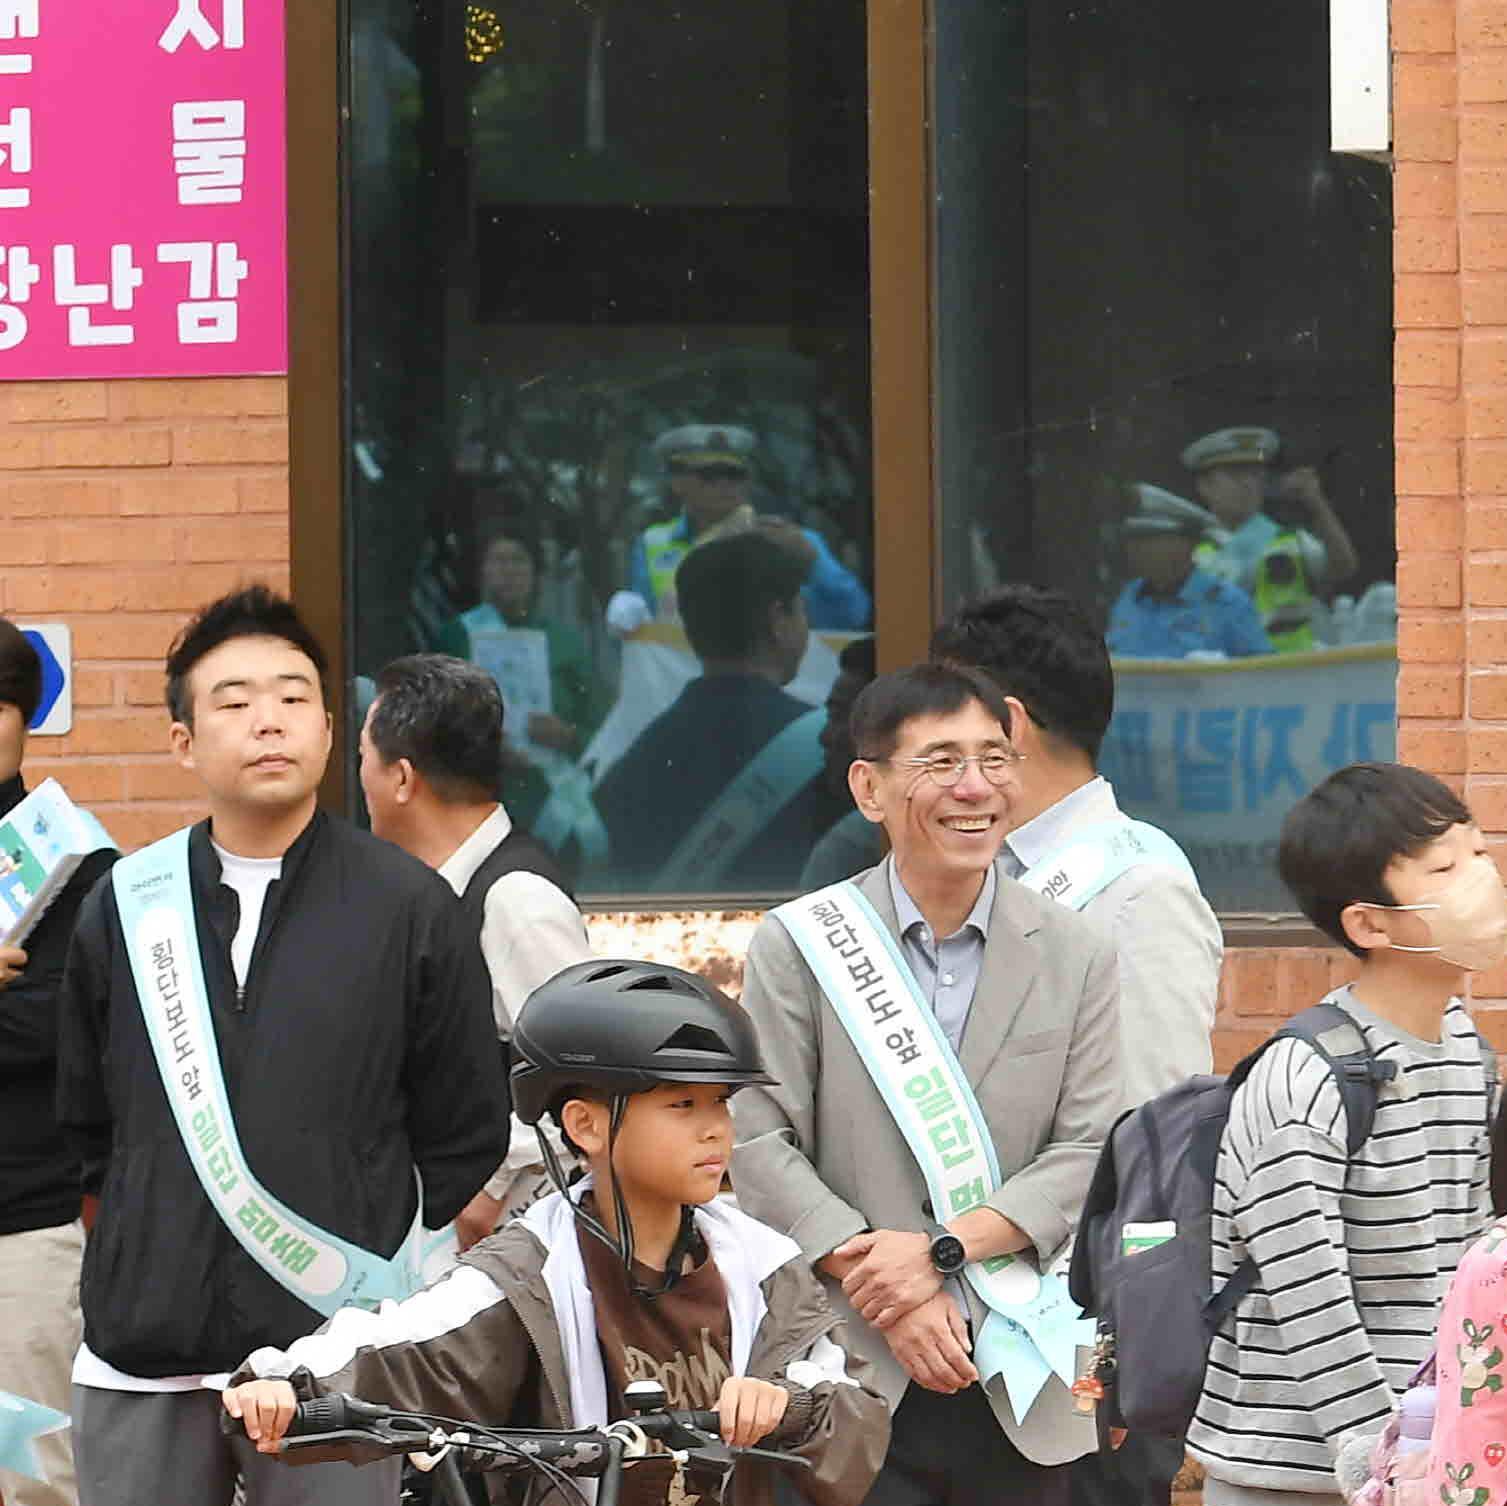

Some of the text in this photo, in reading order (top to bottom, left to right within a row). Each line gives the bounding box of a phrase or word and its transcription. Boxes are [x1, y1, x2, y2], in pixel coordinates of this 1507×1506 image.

[150, 937, 196, 1064] 횡단보도
[808, 899, 903, 1028] 횡단보도
[885, 1026, 923, 1065] 앞
